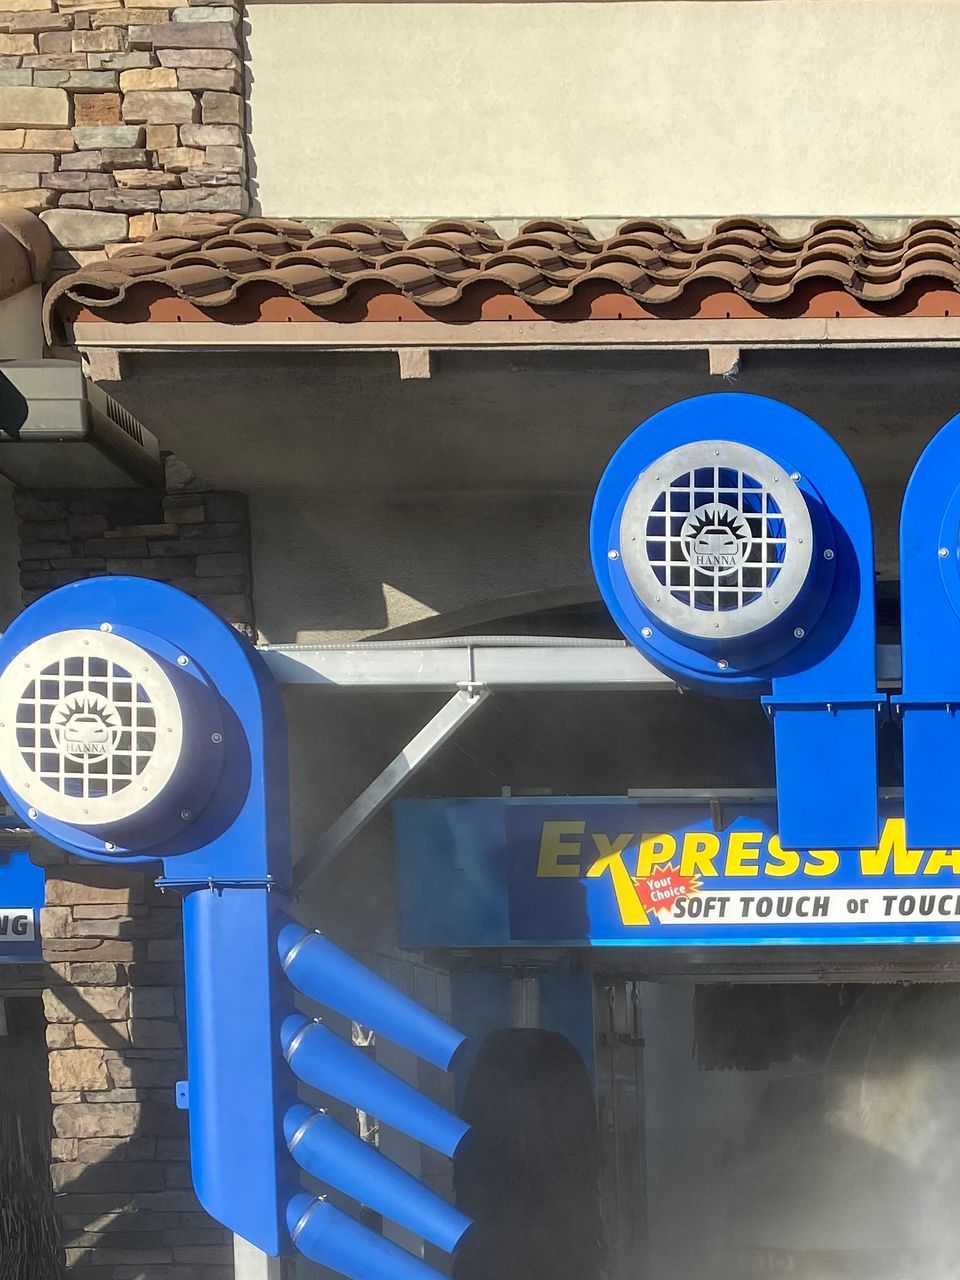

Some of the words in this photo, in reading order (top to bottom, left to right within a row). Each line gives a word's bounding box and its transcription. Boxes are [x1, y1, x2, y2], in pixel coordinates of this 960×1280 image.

[696, 555, 736, 565] HANNA
[66, 743, 107, 753] HANNA
[646, 876, 672, 890] Your
[650, 885, 687, 902] Choice
[673, 896, 730, 918] SOFT
[741, 896, 830, 917] TOUCH
[846, 899, 869, 914] or
